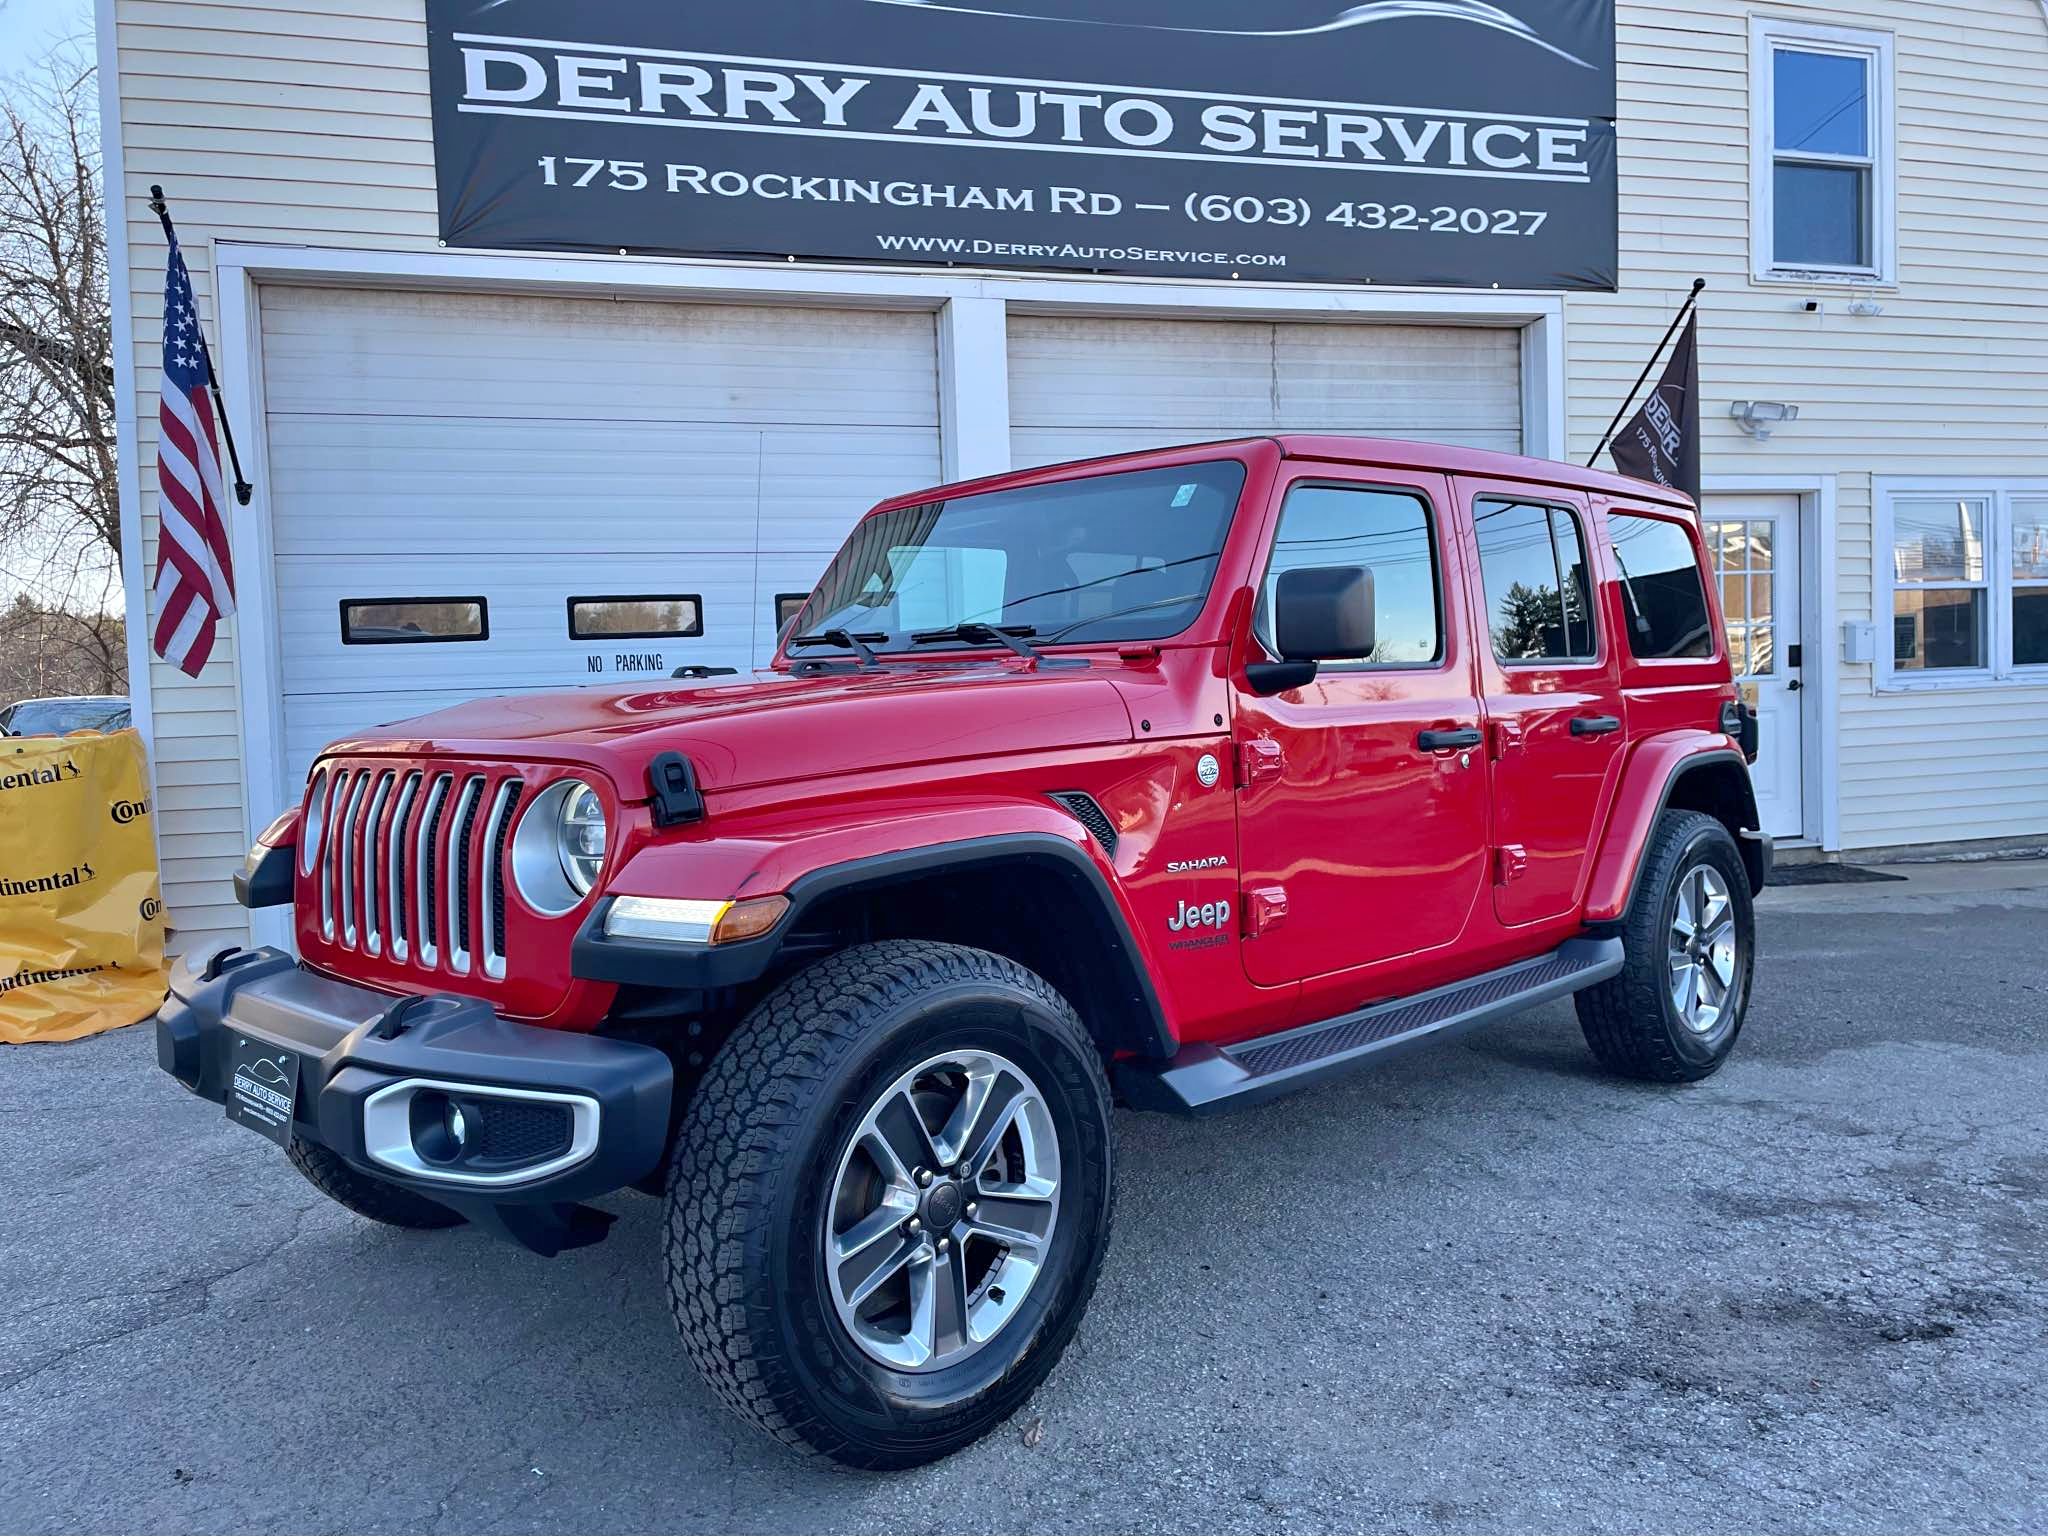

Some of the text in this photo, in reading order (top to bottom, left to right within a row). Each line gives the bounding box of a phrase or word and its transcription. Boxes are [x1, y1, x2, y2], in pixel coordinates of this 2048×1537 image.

[460, 47, 1588, 174] DERRY AUTO SERVICE
[537, 155, 648, 191] 175
[665, 163, 1035, 212] ROCKINGHAM
[1184, 192, 1311, 227] (603)
[1325, 201, 1548, 236] 432-2027
[588, 653, 663, 672] NO PARKING
[1167, 855, 1229, 873] SAHARA
[1168, 900, 1231, 932] Jeep
[234, 1075, 253, 1092] DERRY
[252, 1085, 267, 1100] AUTO
